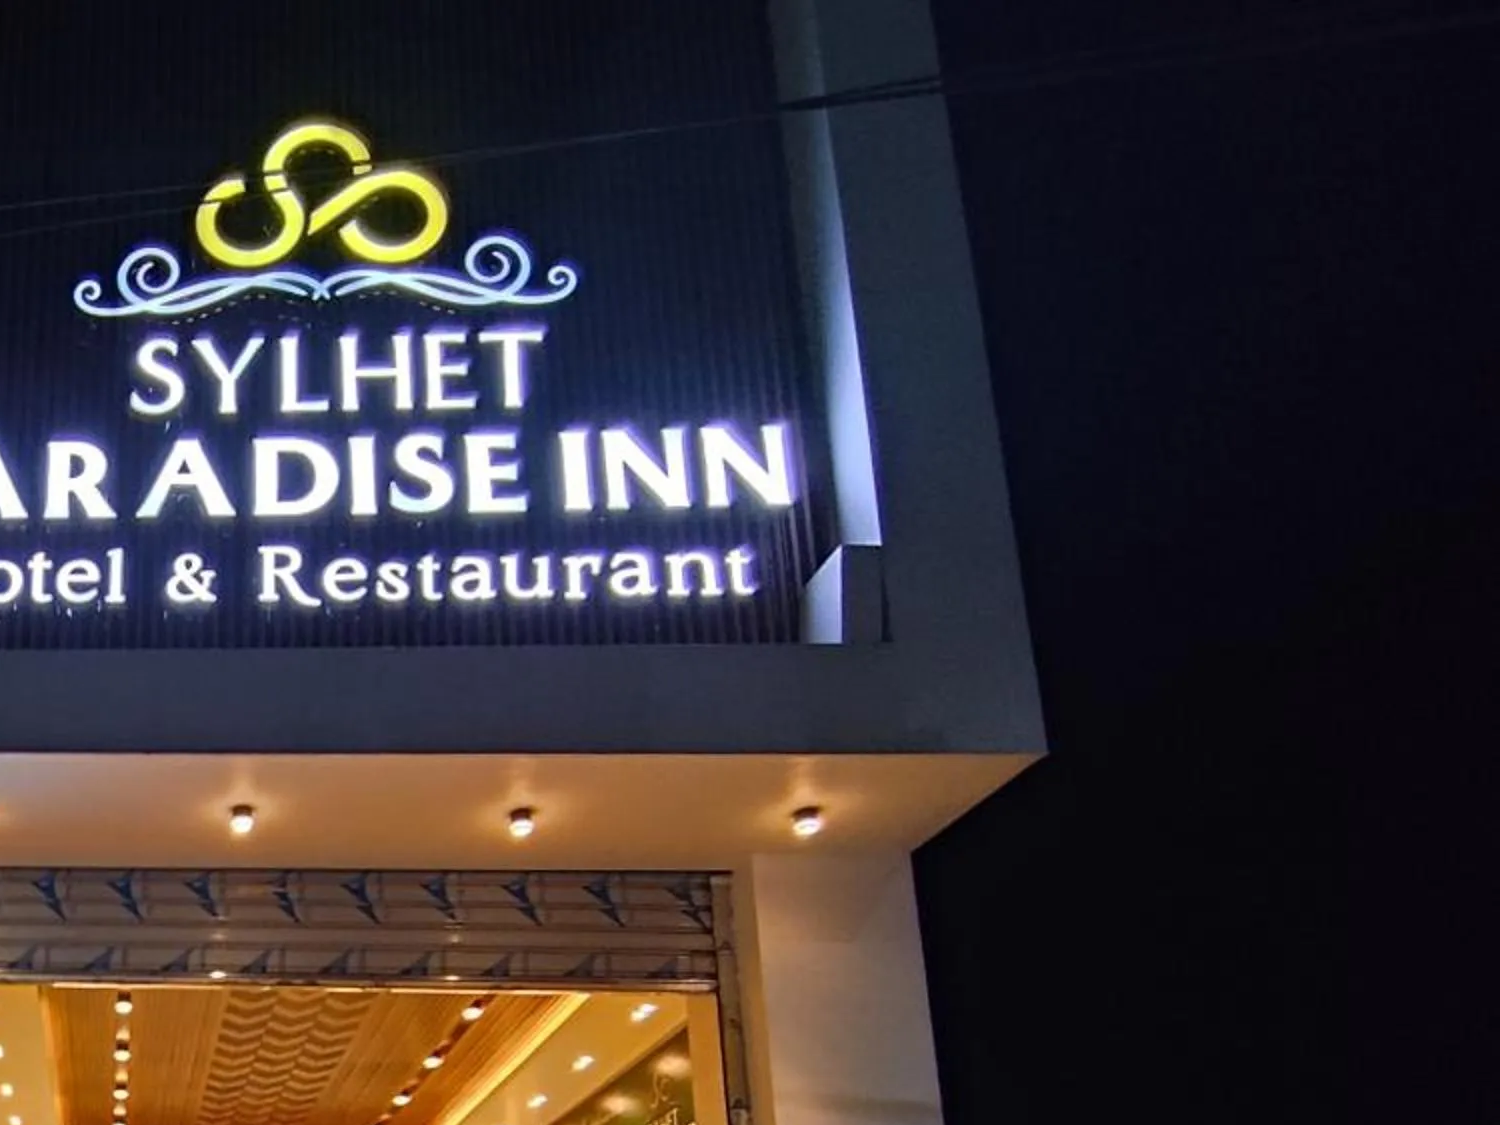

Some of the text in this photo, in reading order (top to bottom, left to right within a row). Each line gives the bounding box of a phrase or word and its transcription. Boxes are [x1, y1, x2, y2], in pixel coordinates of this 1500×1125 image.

[130, 327, 544, 415] SYLHET
[557, 421, 795, 513] INN
[167, 552, 218, 603] &
[258, 543, 757, 608] Restaurant
